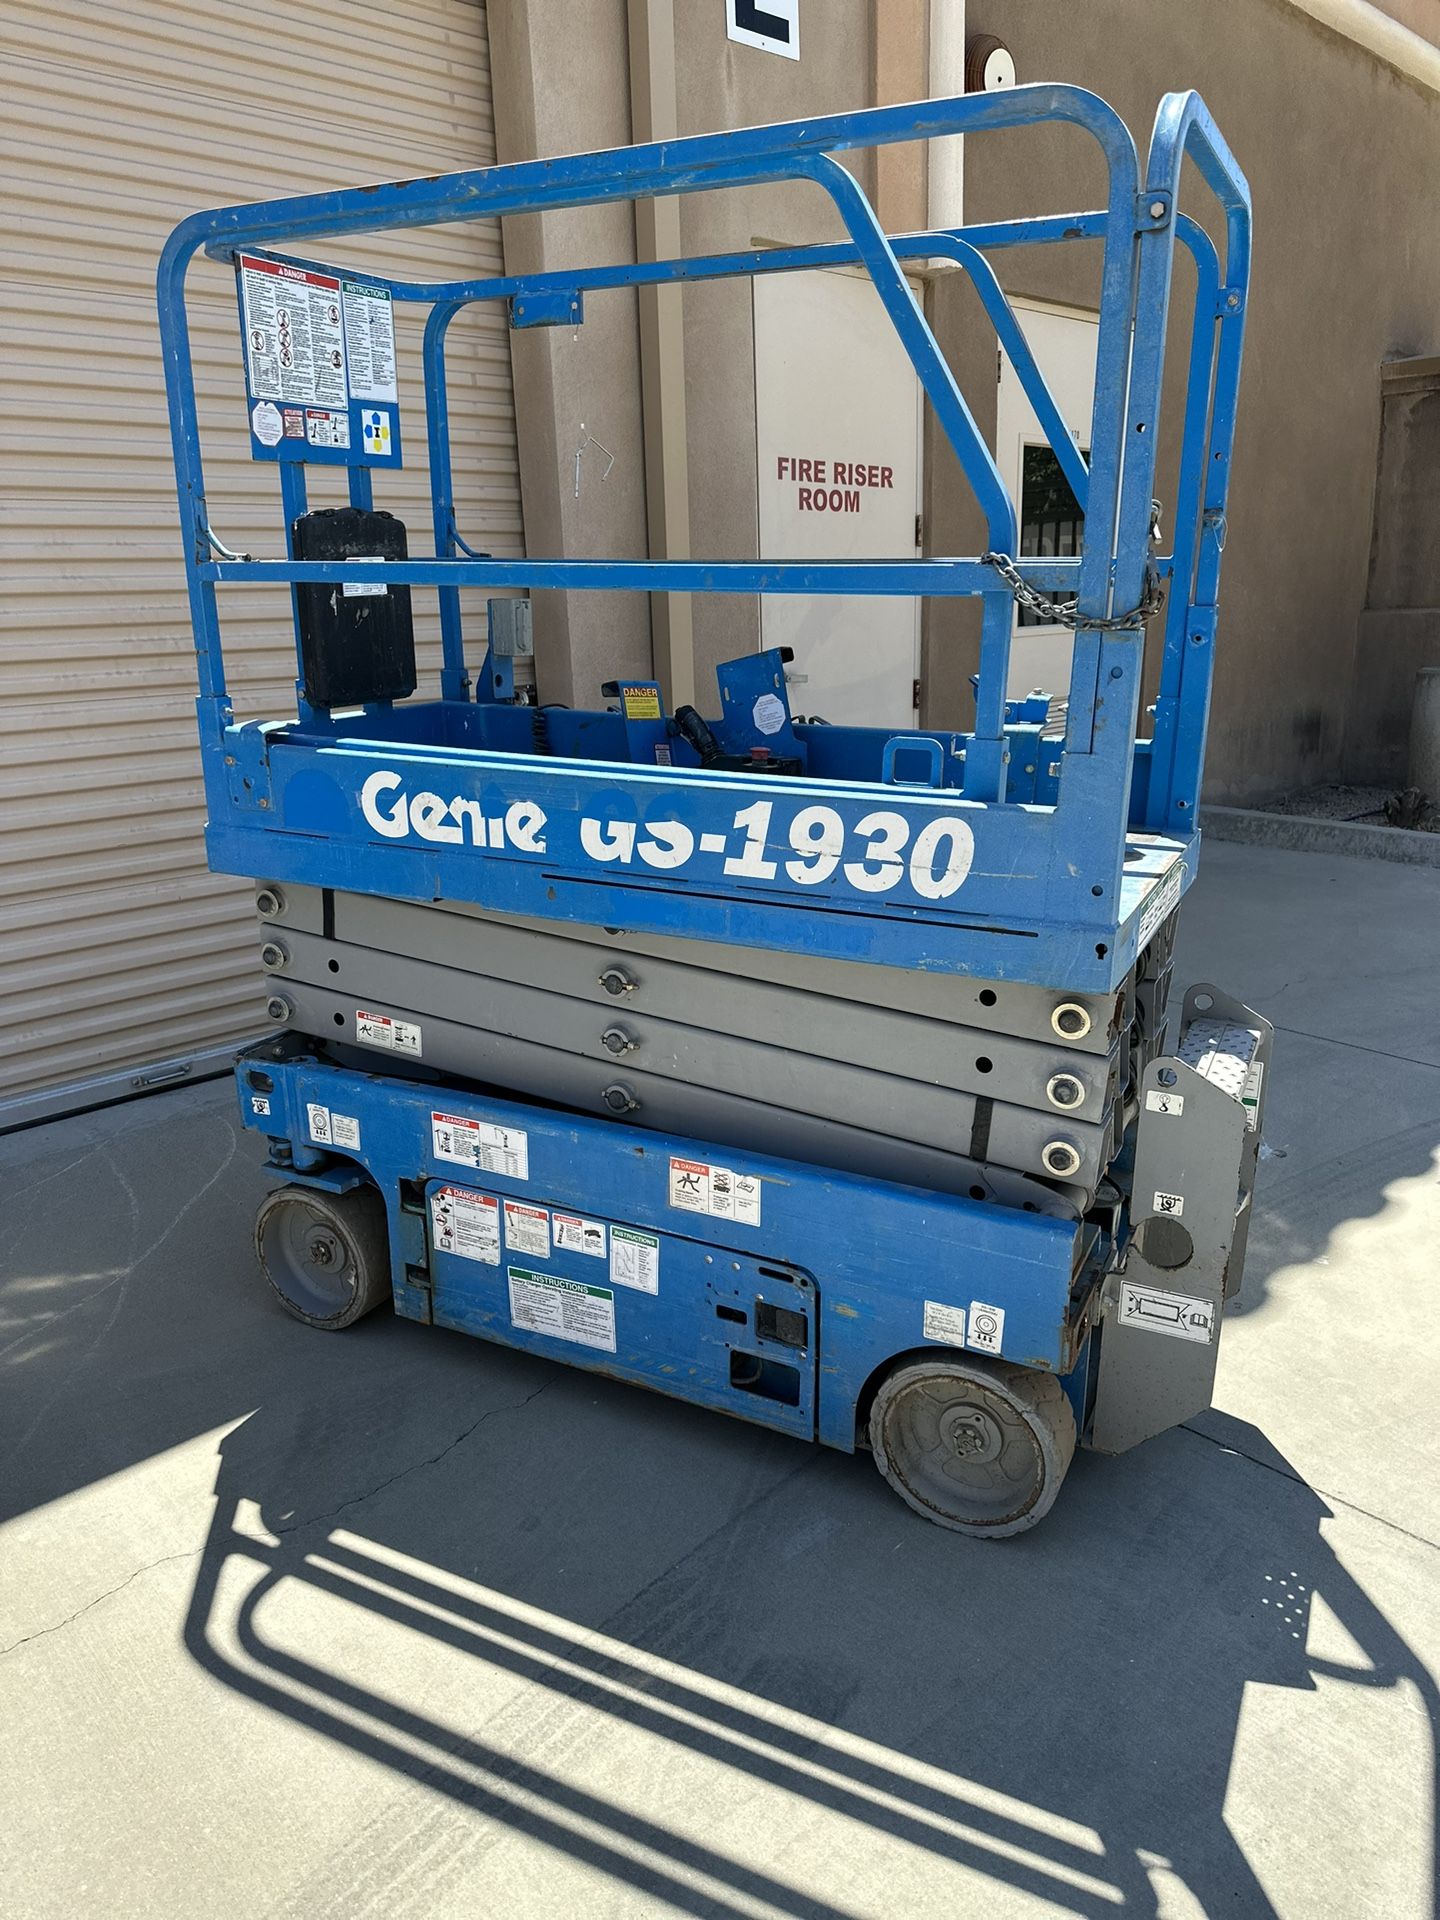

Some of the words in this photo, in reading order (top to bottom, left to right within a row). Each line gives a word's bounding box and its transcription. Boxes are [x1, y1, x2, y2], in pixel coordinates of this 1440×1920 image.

[284, 268, 307, 281] DANGER
[346, 284, 387, 299] INSTRUCTIONS
[777, 456, 826, 483] FIRE
[833, 462, 893, 488] RISER
[798, 487, 860, 513] ROOM
[623, 687, 658, 697] DANGER
[361, 770, 548, 854] Genie
[580, 800, 975, 900] GS-1930
[446, 1117, 470, 1127] DANGER
[681, 1165, 706, 1174] DANGER
[453, 1189, 484, 1203] DANGER
[519, 1207, 539, 1217] DANGER
[613, 1230, 655, 1246] INSTRUCTIONS
[531, 1274, 589, 1294] INSTRUCTIONS
